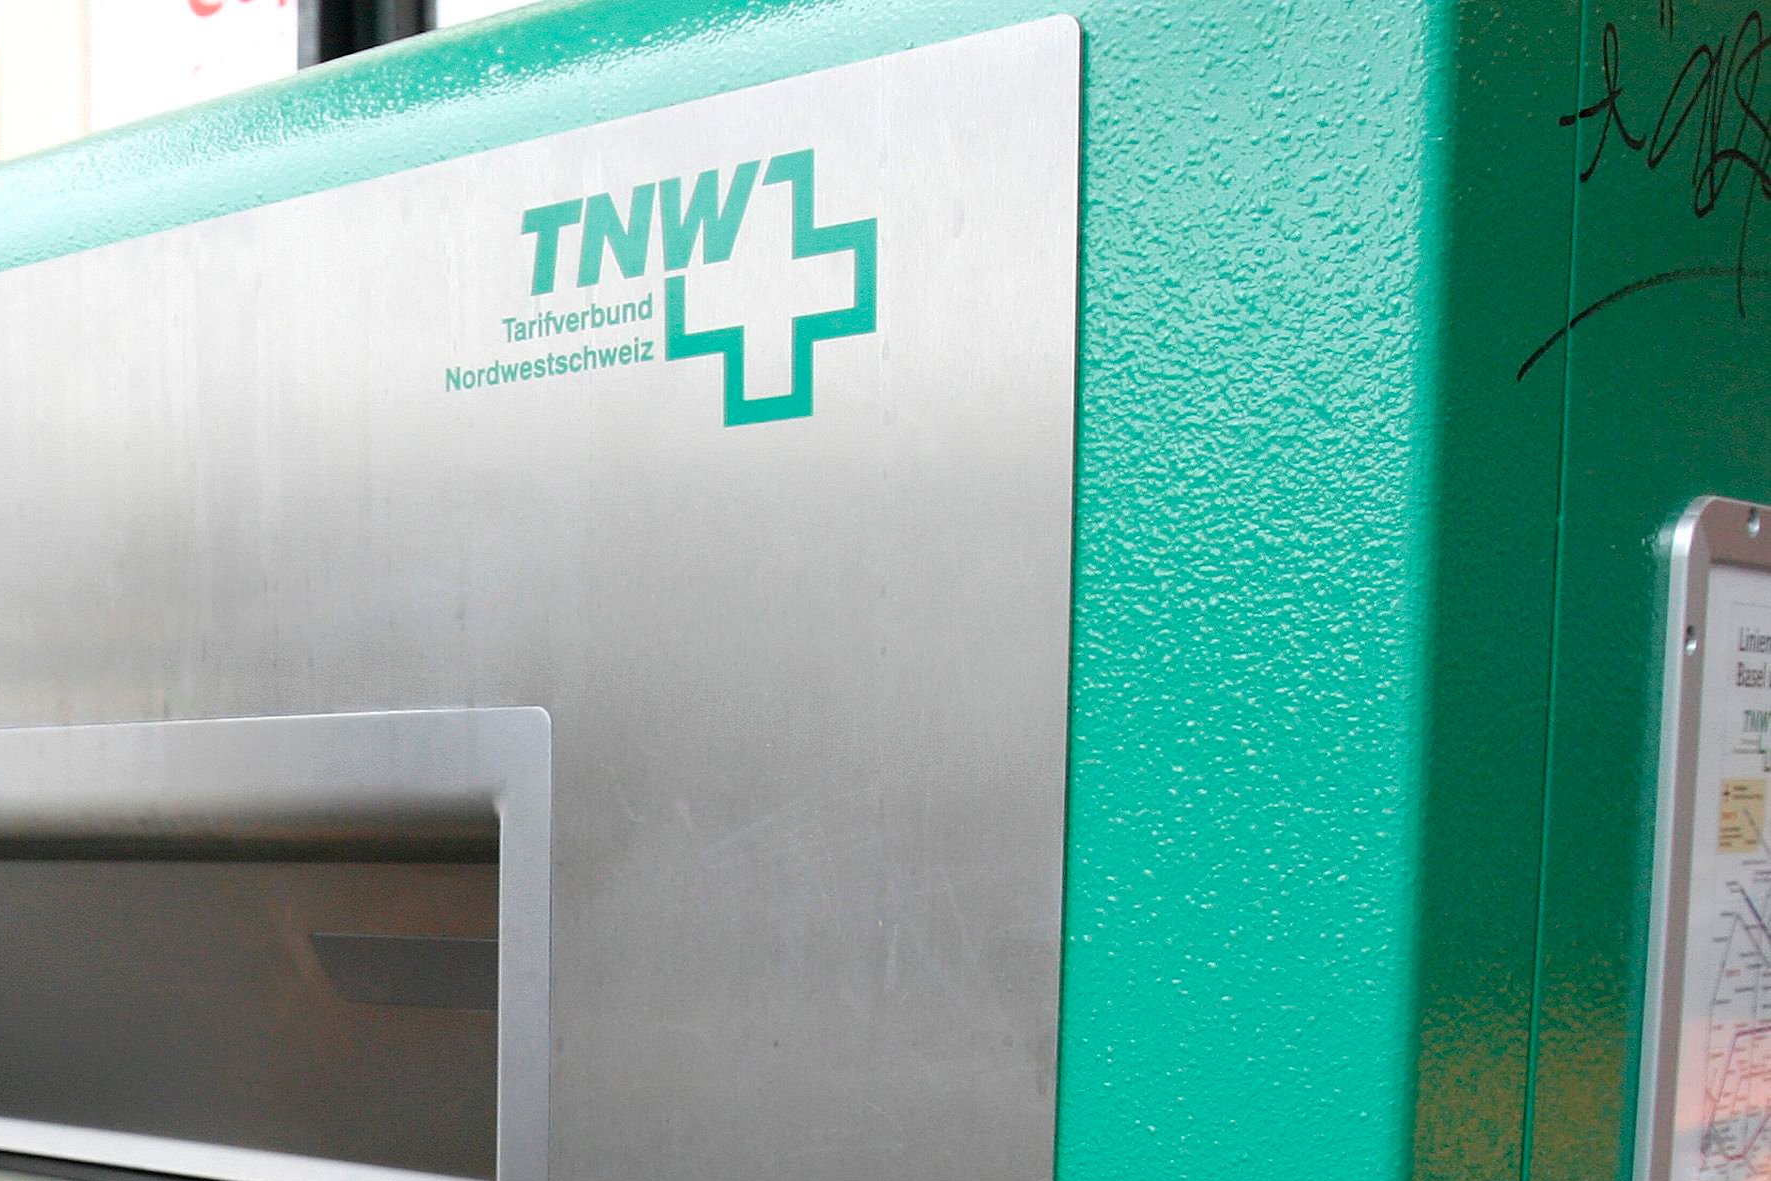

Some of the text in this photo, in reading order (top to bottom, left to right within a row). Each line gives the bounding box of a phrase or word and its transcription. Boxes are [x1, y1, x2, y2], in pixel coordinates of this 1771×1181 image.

[520, 159, 762, 296] TNW
[502, 293, 654, 343] Tarifverbund
[445, 337, 655, 392] Nordwestschweiz
